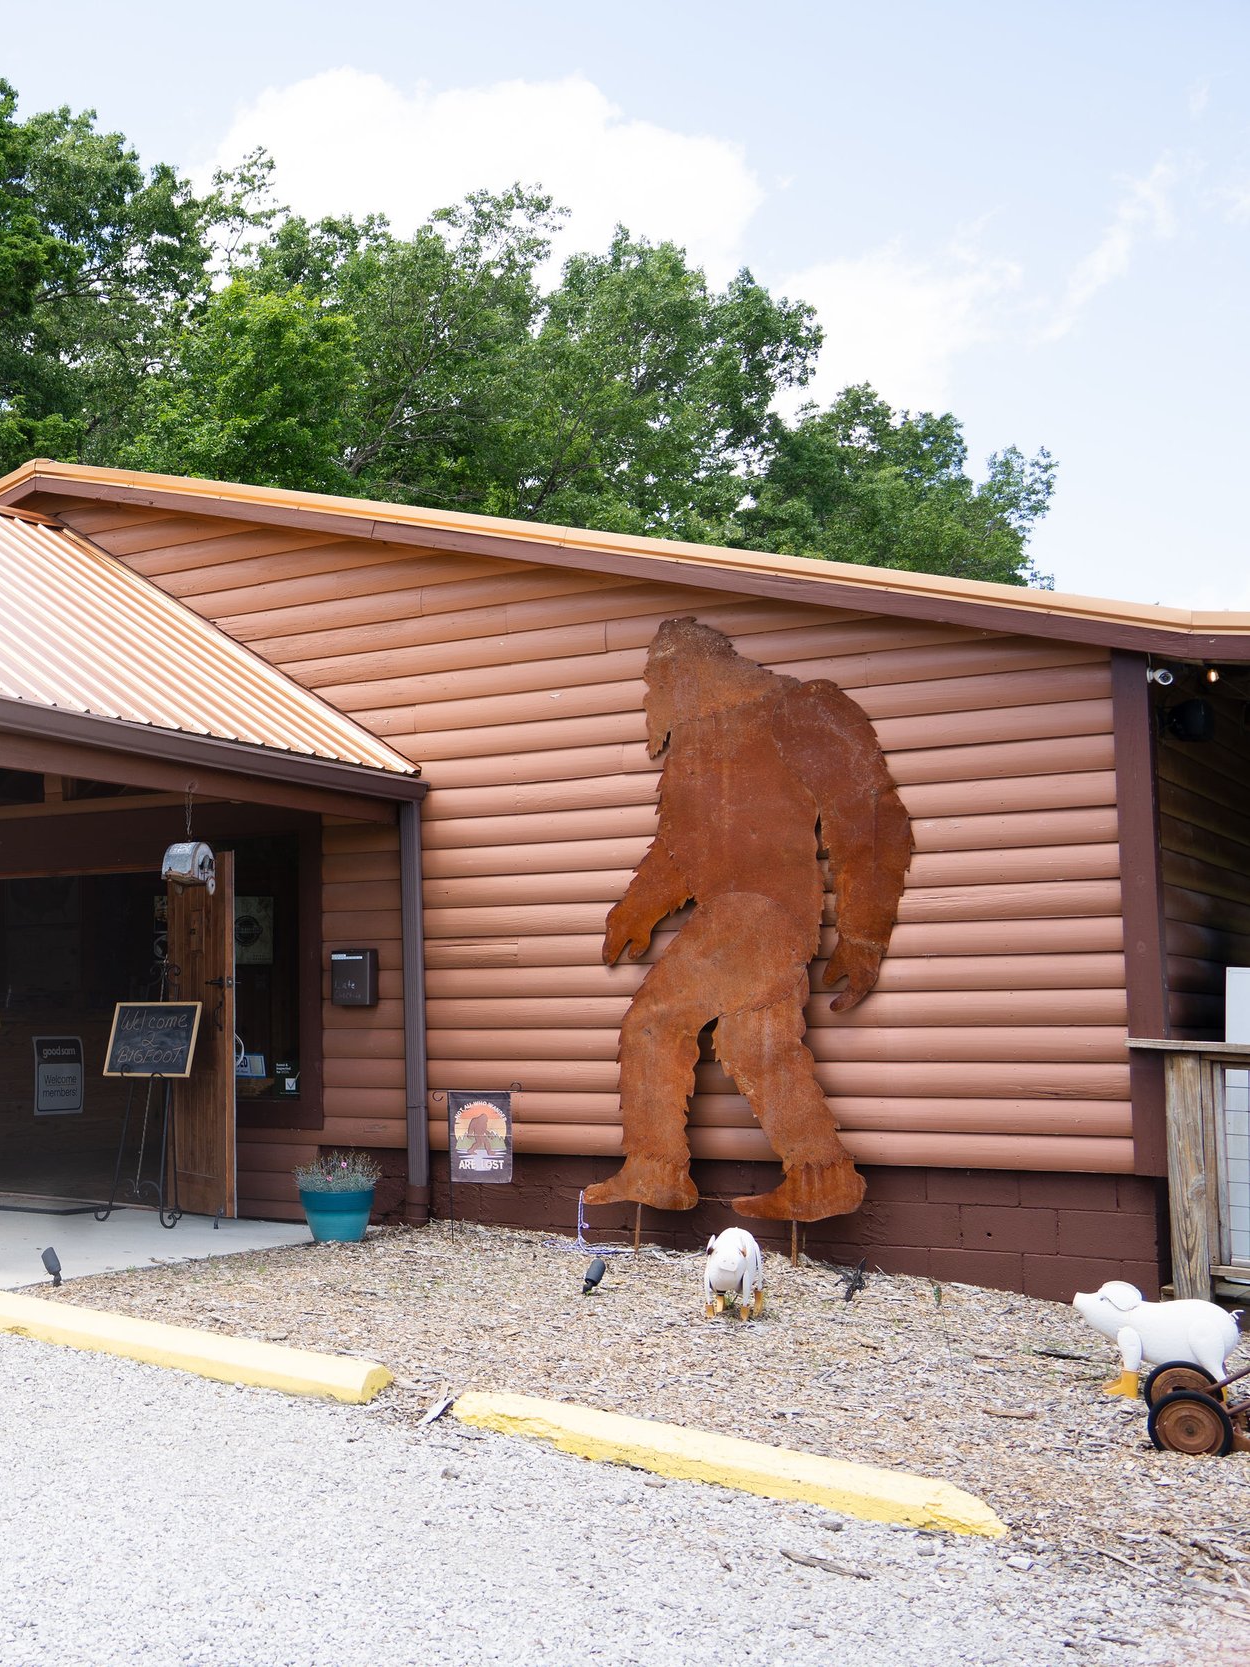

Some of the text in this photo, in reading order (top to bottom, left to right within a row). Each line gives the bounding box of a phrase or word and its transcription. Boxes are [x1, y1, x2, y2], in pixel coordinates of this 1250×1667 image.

[121, 1009, 189, 1031] Welcome
[141, 1031, 160, 1047] 2
[117, 1045, 188, 1063] BIGFOOT
[44, 1074, 77, 1085] Welcome
[42, 1087, 78, 1098] members!
[454, 1107, 464, 1120] NOT
[459, 1160, 504, 1169] ARE LOST
